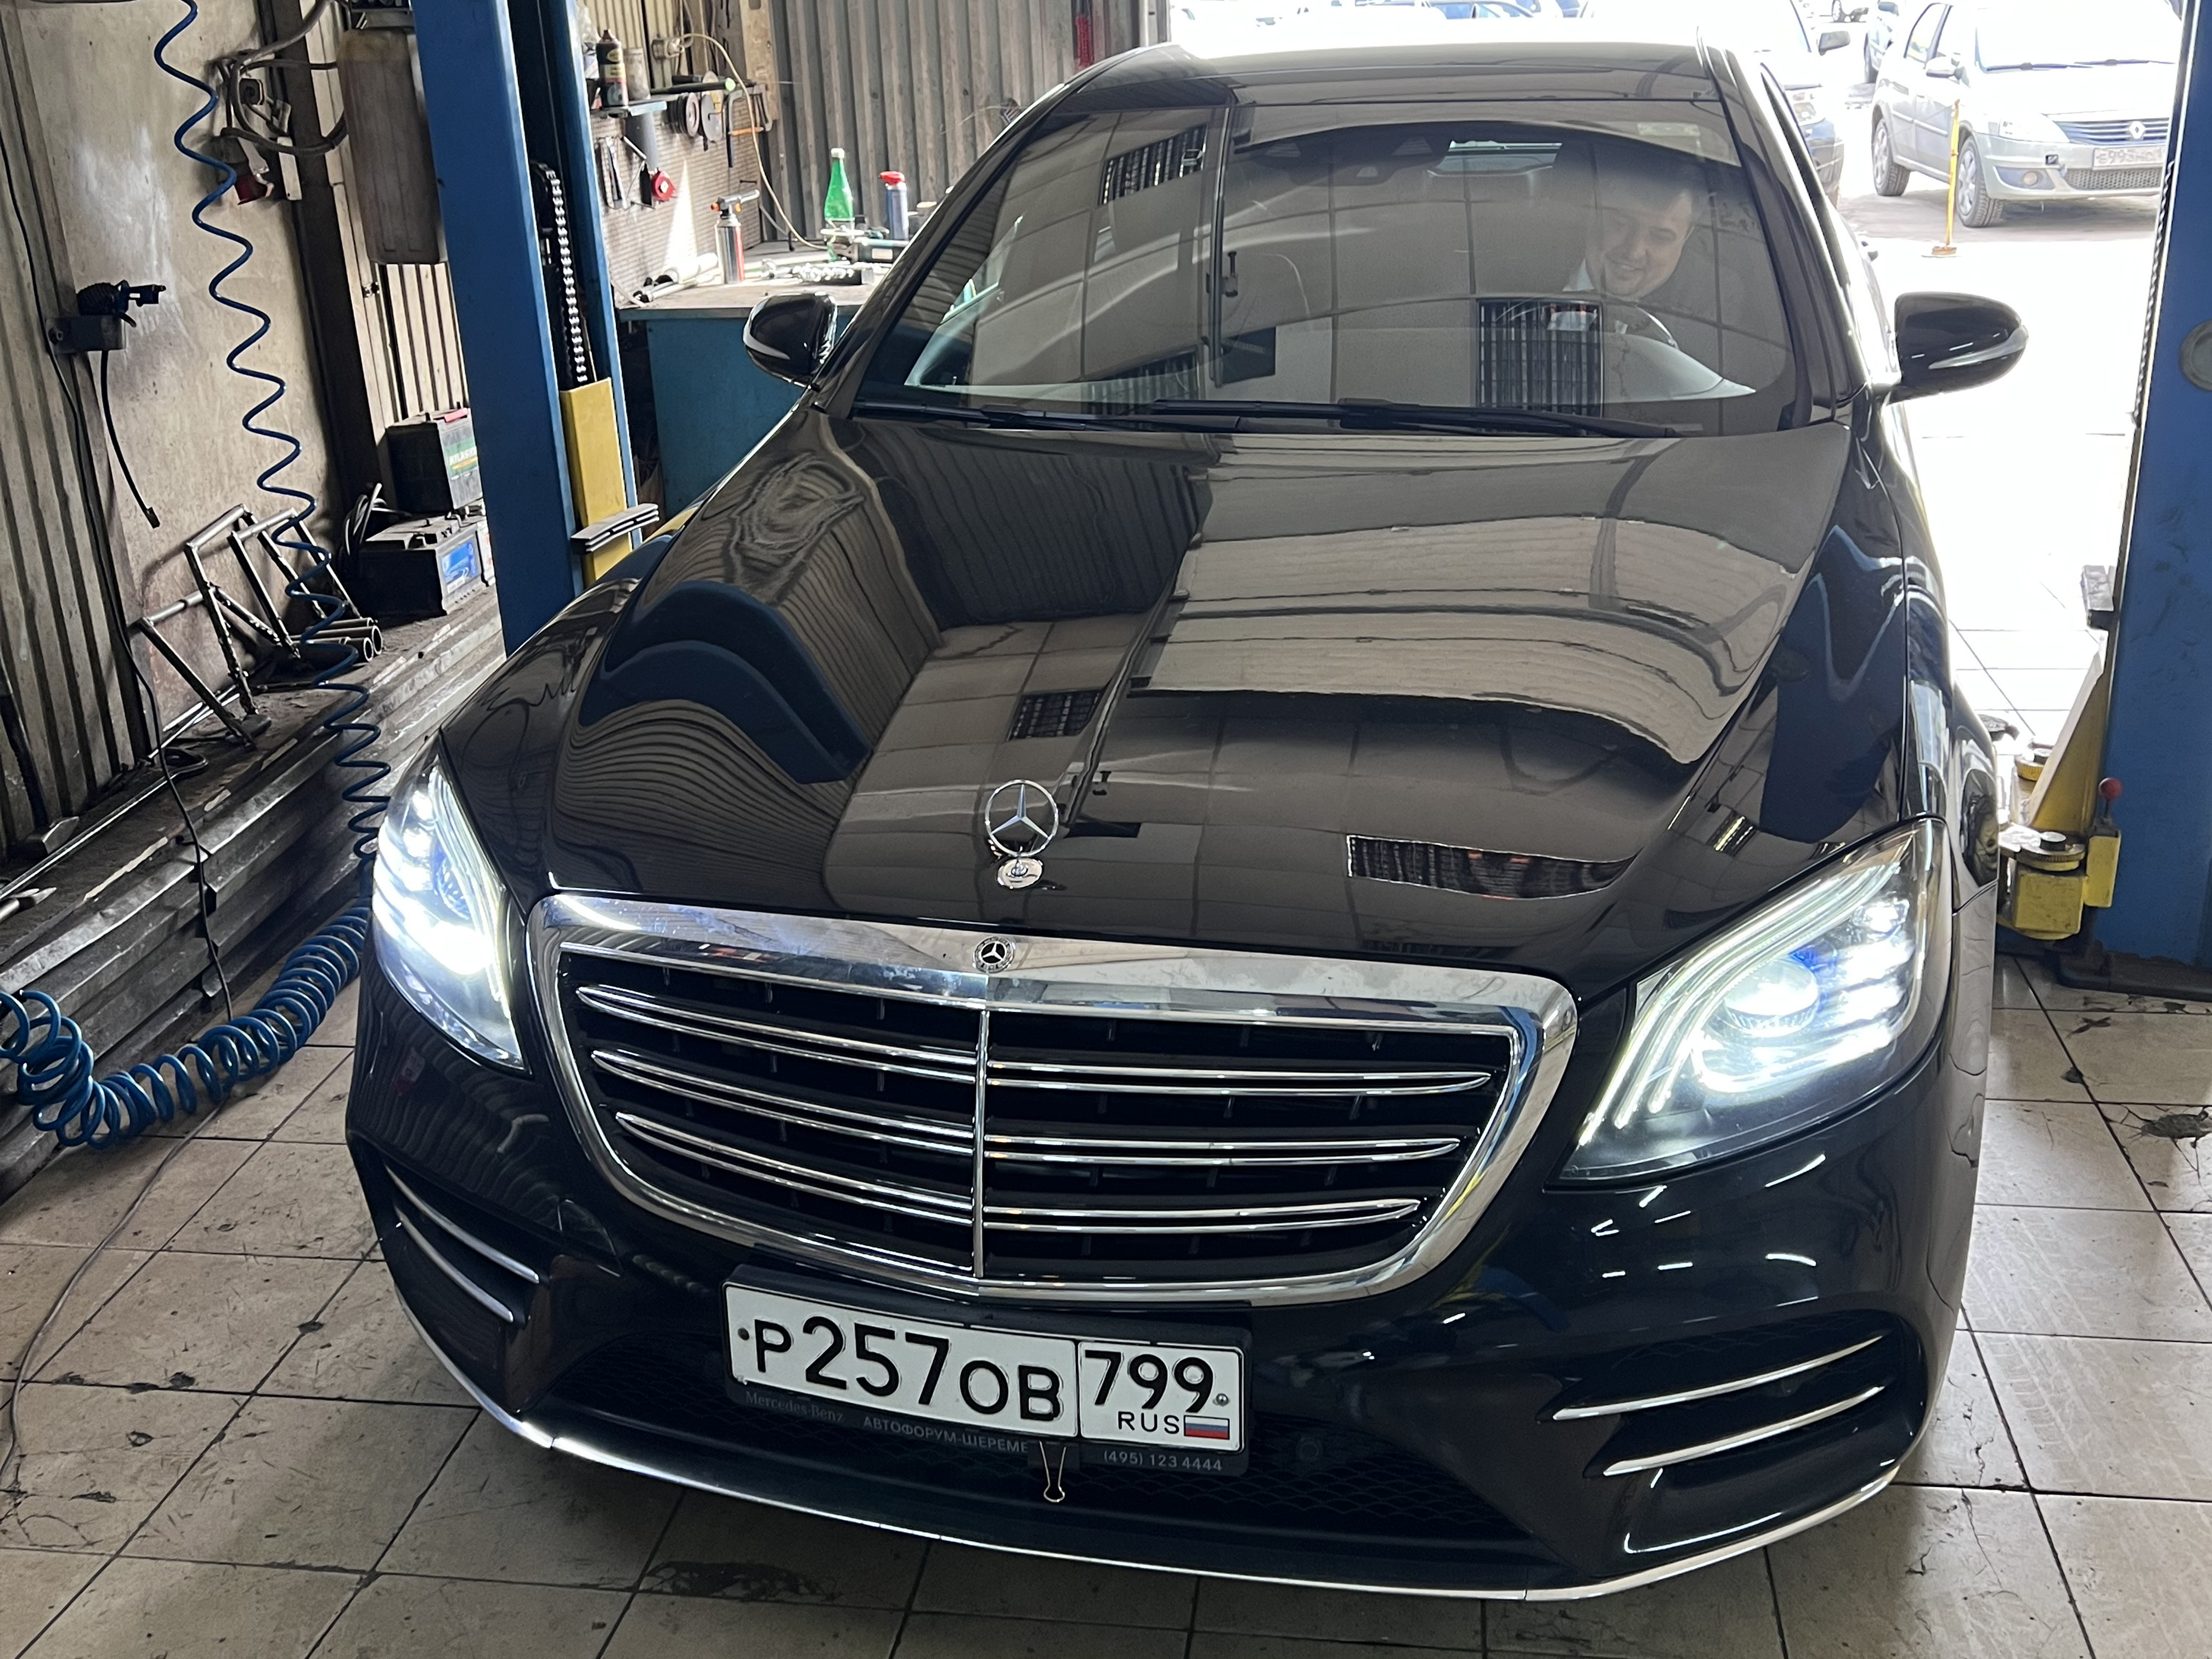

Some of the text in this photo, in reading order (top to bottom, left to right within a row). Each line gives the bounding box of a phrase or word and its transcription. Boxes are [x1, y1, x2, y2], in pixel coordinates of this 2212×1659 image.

[754, 1316, 1214, 1421] Р257ОВ 799
[746, 1391, 844, 1423] Mercedes-Benz
[1118, 1411, 1180, 1435] RUS
[864, 1415, 1028, 1453] АВТОФОРУМ-ШЕРЕМЕ
[1104, 1449, 1223, 1471] (495) 123 4444
